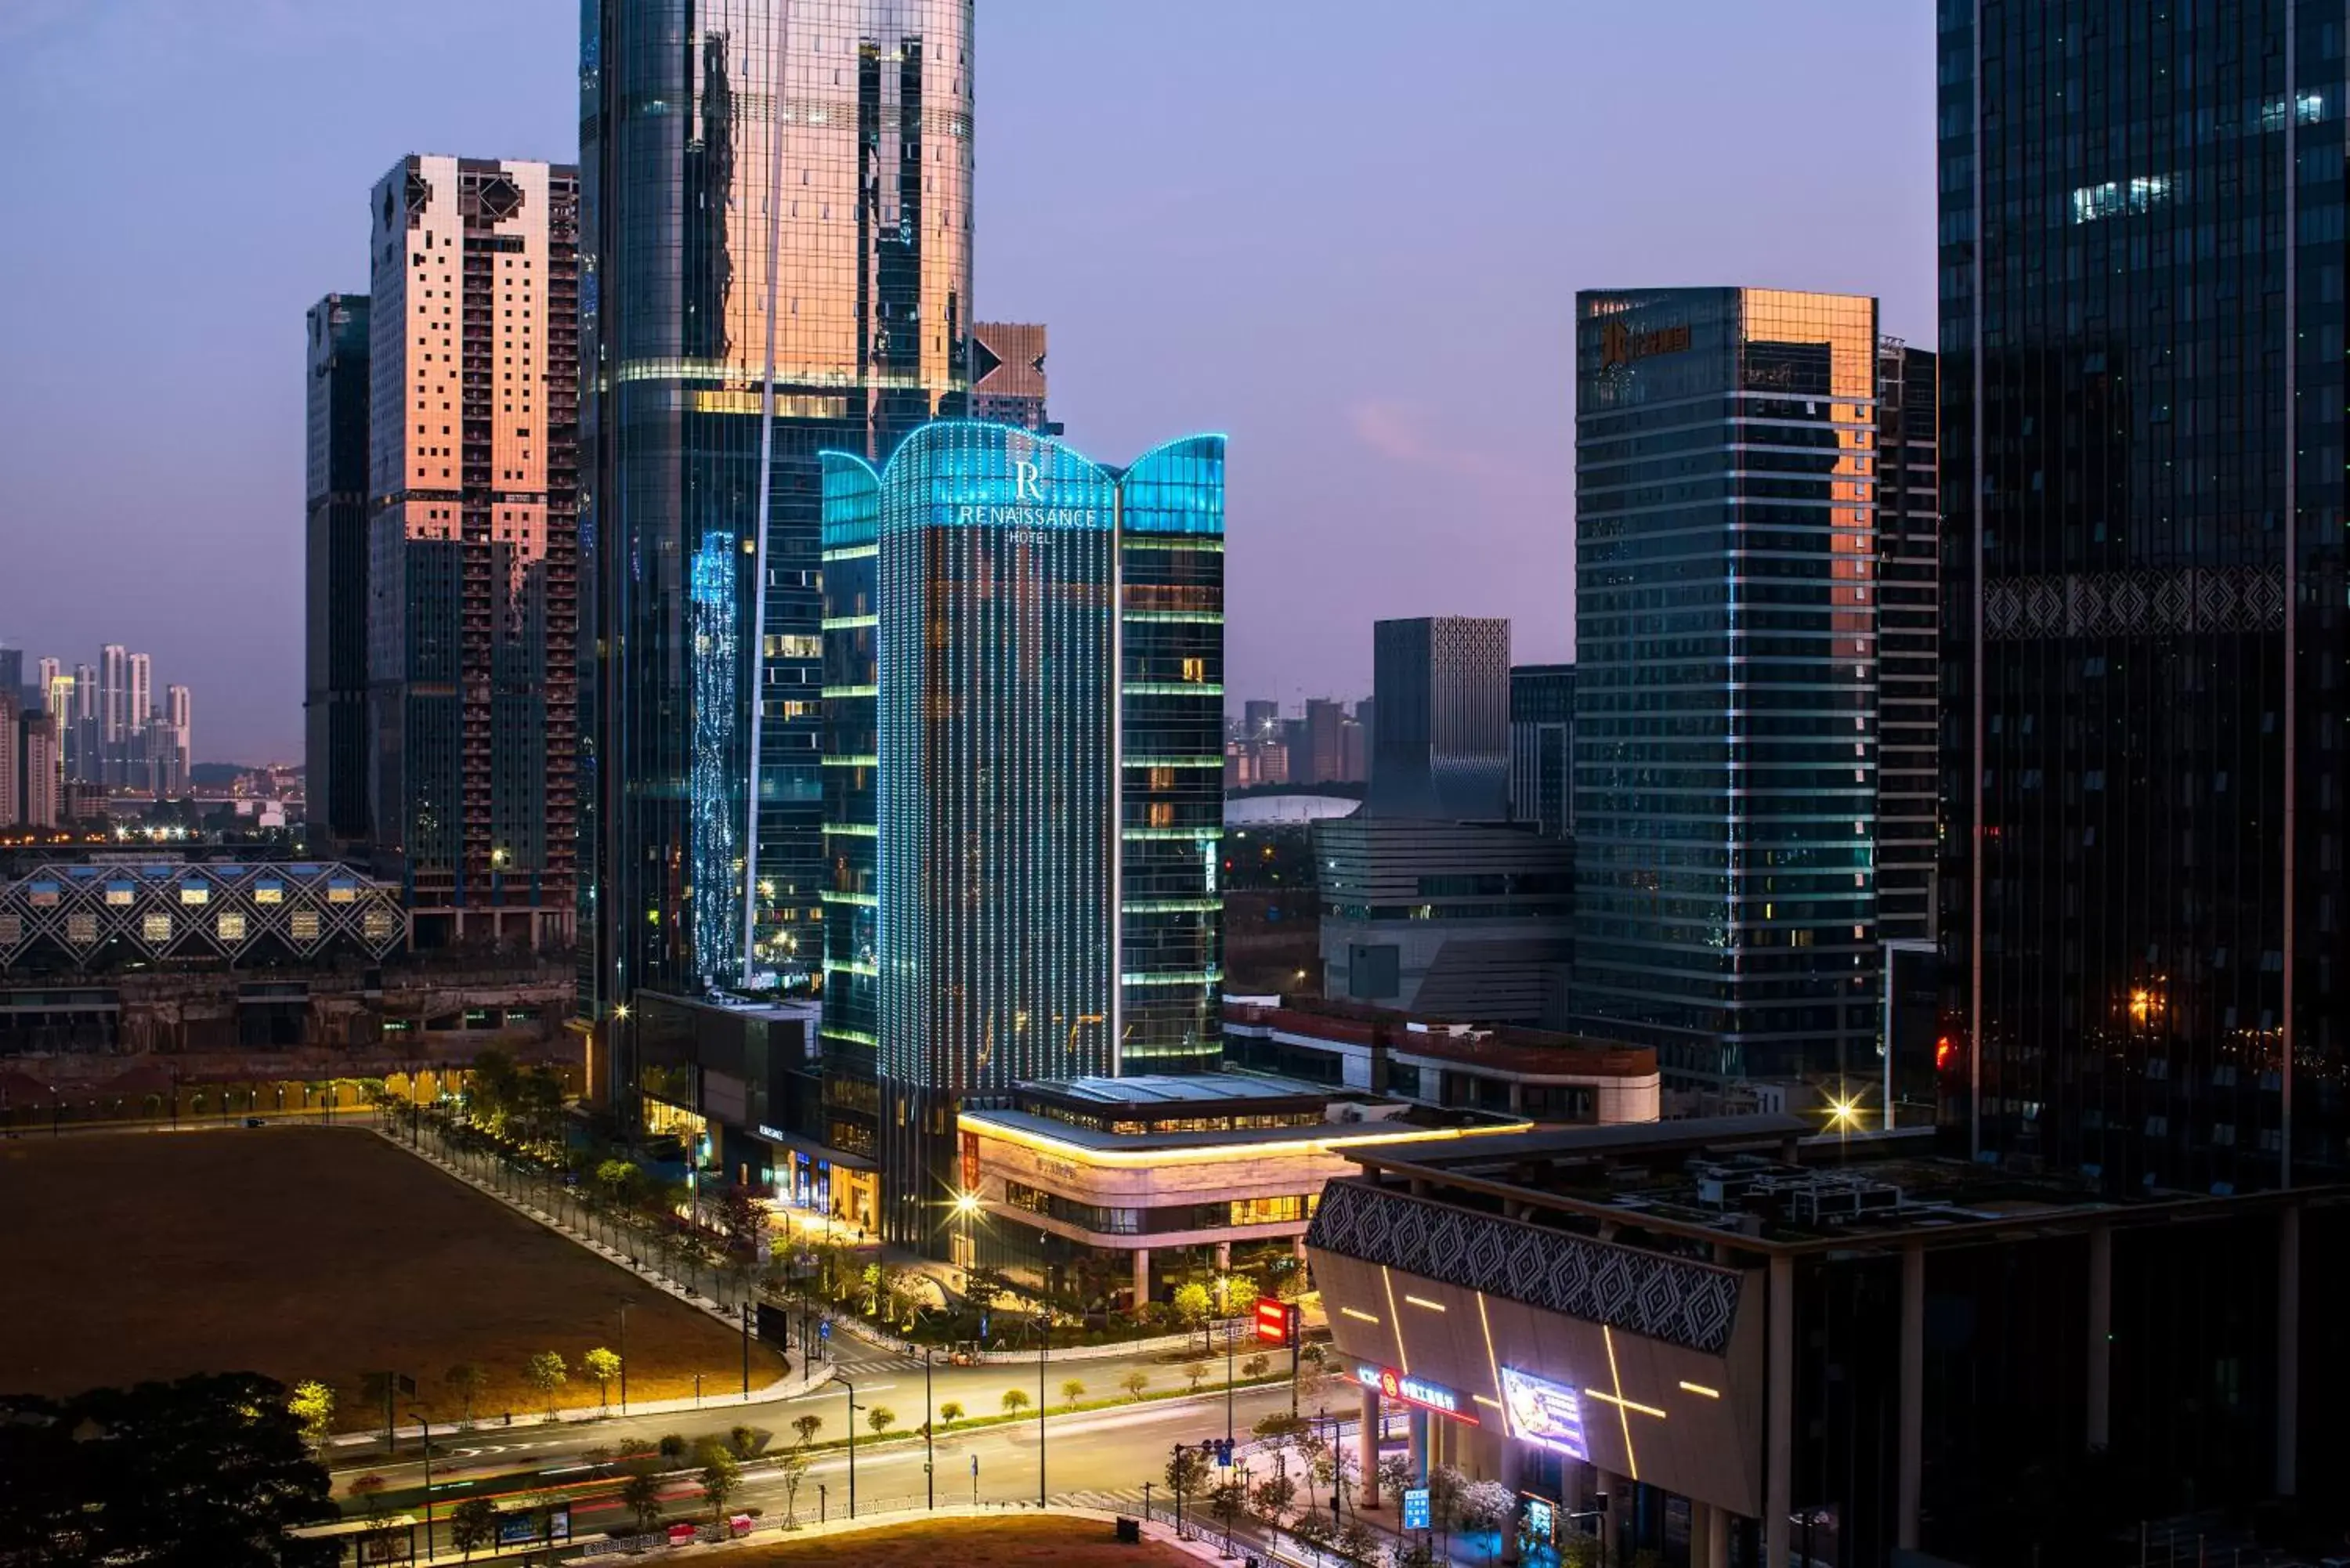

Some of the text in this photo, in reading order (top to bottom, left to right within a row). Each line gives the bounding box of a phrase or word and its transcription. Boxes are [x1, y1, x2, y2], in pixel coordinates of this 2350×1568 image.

[1015, 461, 1044, 500] R
[960, 505, 1097, 527] RENAISSANCE
[1009, 531, 1052, 544] HOTEL
